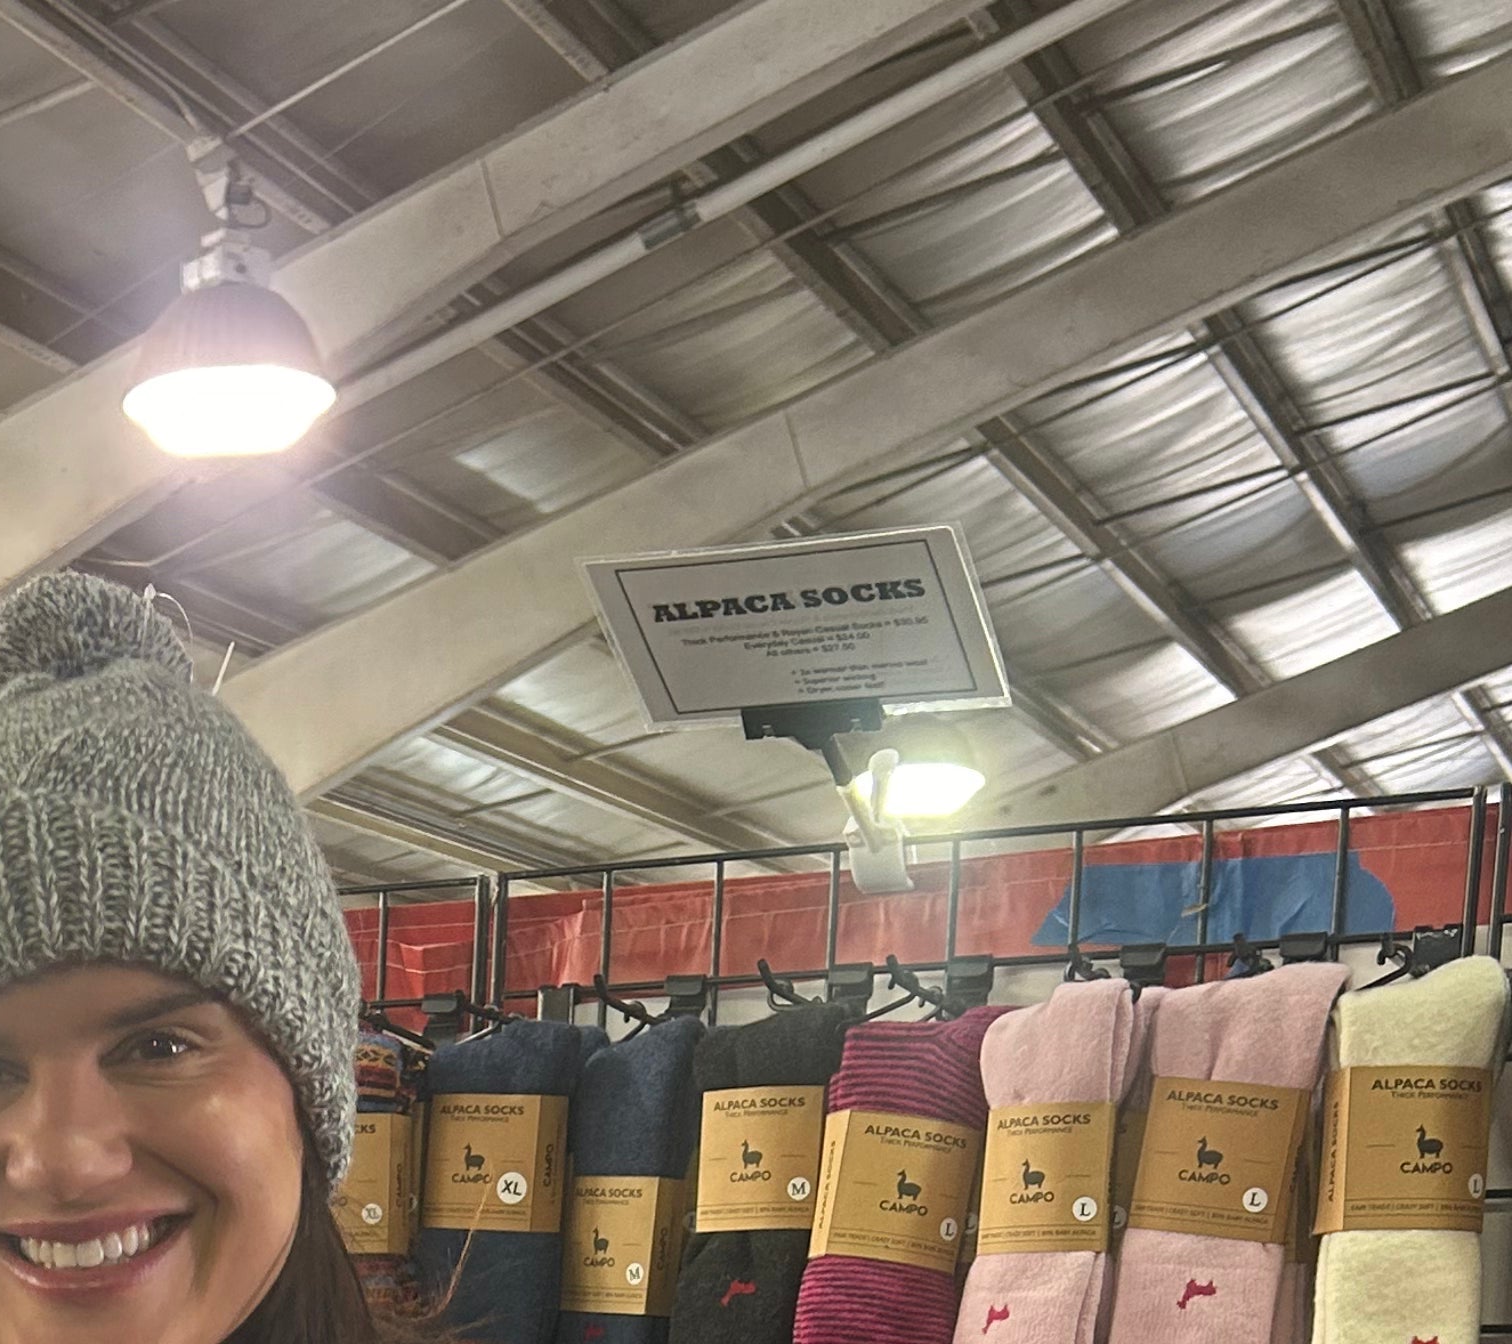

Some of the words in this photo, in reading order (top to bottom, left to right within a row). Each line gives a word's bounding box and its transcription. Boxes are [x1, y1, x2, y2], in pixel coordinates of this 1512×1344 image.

[654, 593, 795, 622] ALPACA
[802, 579, 926, 608] SOCKS
[1371, 1079, 1436, 1090] ALPACA
[1439, 1079, 1482, 1092] SOCKS
[714, 1099, 757, 1111] ALPACA
[760, 1097, 806, 1108] SOCKS
[1167, 1090, 1223, 1104] ALPACA
[1227, 1095, 1279, 1110] SOCKS
[440, 1105, 480, 1114] ALPACA
[484, 1105, 524, 1115] SOCKS
[997, 1117, 1038, 1130] ALPACA
[1042, 1114, 1091, 1125] SOCKS
[864, 1125, 920, 1140] ALPACA
[925, 1132, 967, 1149] SOCKS
[1400, 1162, 1453, 1174] CAMPO
[452, 1173, 491, 1184] CAMPO
[730, 1170, 771, 1182] CAMPO
[1178, 1169, 1231, 1185] CAMPO
[502, 1180, 522, 1196] XL
[608, 1188, 643, 1198] SOCKS
[792, 1182, 806, 1196] M
[1473, 1179, 1480, 1194] L
[1009, 1191, 1054, 1204] CAMPO
[1249, 1192, 1261, 1207] L
[880, 1200, 928, 1217] CAMPO
[1080, 1203, 1090, 1217] L
[945, 1223, 954, 1237] L
[583, 1257, 615, 1267] CAMPO
[629, 1267, 640, 1280] M
